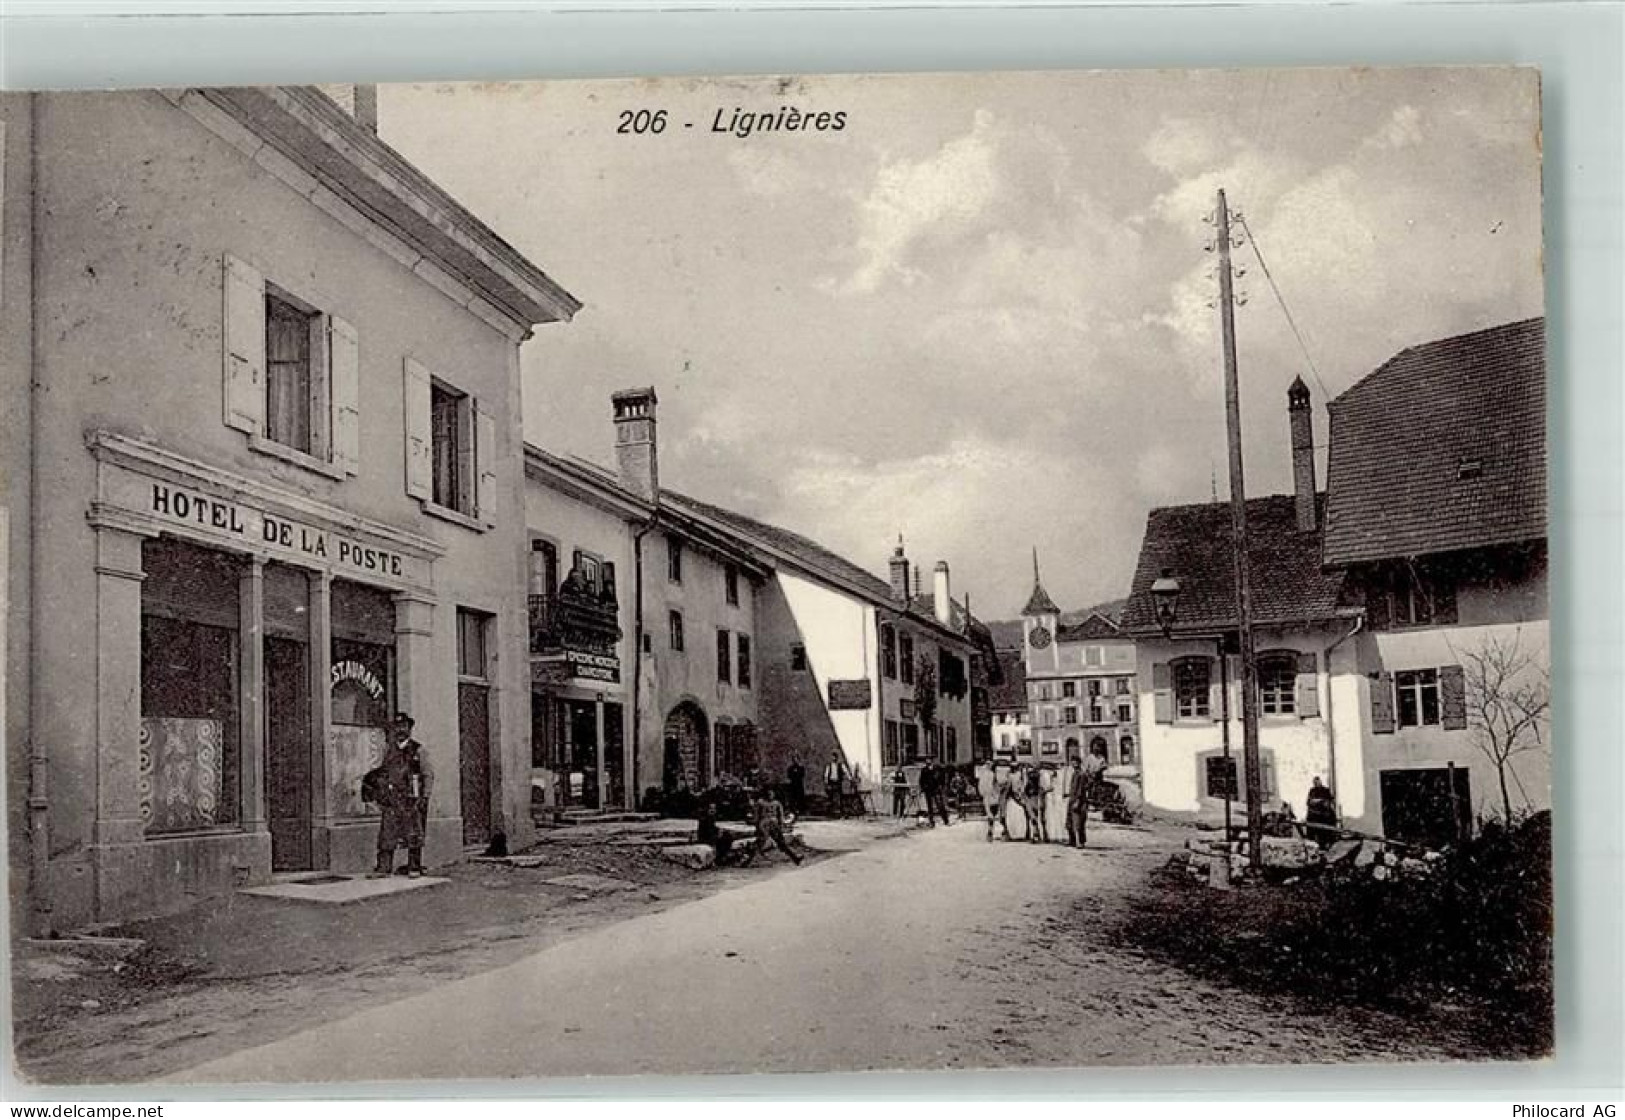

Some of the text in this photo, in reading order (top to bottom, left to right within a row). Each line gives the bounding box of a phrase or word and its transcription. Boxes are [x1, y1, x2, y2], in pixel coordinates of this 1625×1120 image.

[152, 484, 403, 576] HOTEL DE LA POSTE
[330, 660, 385, 699] STAURANT
